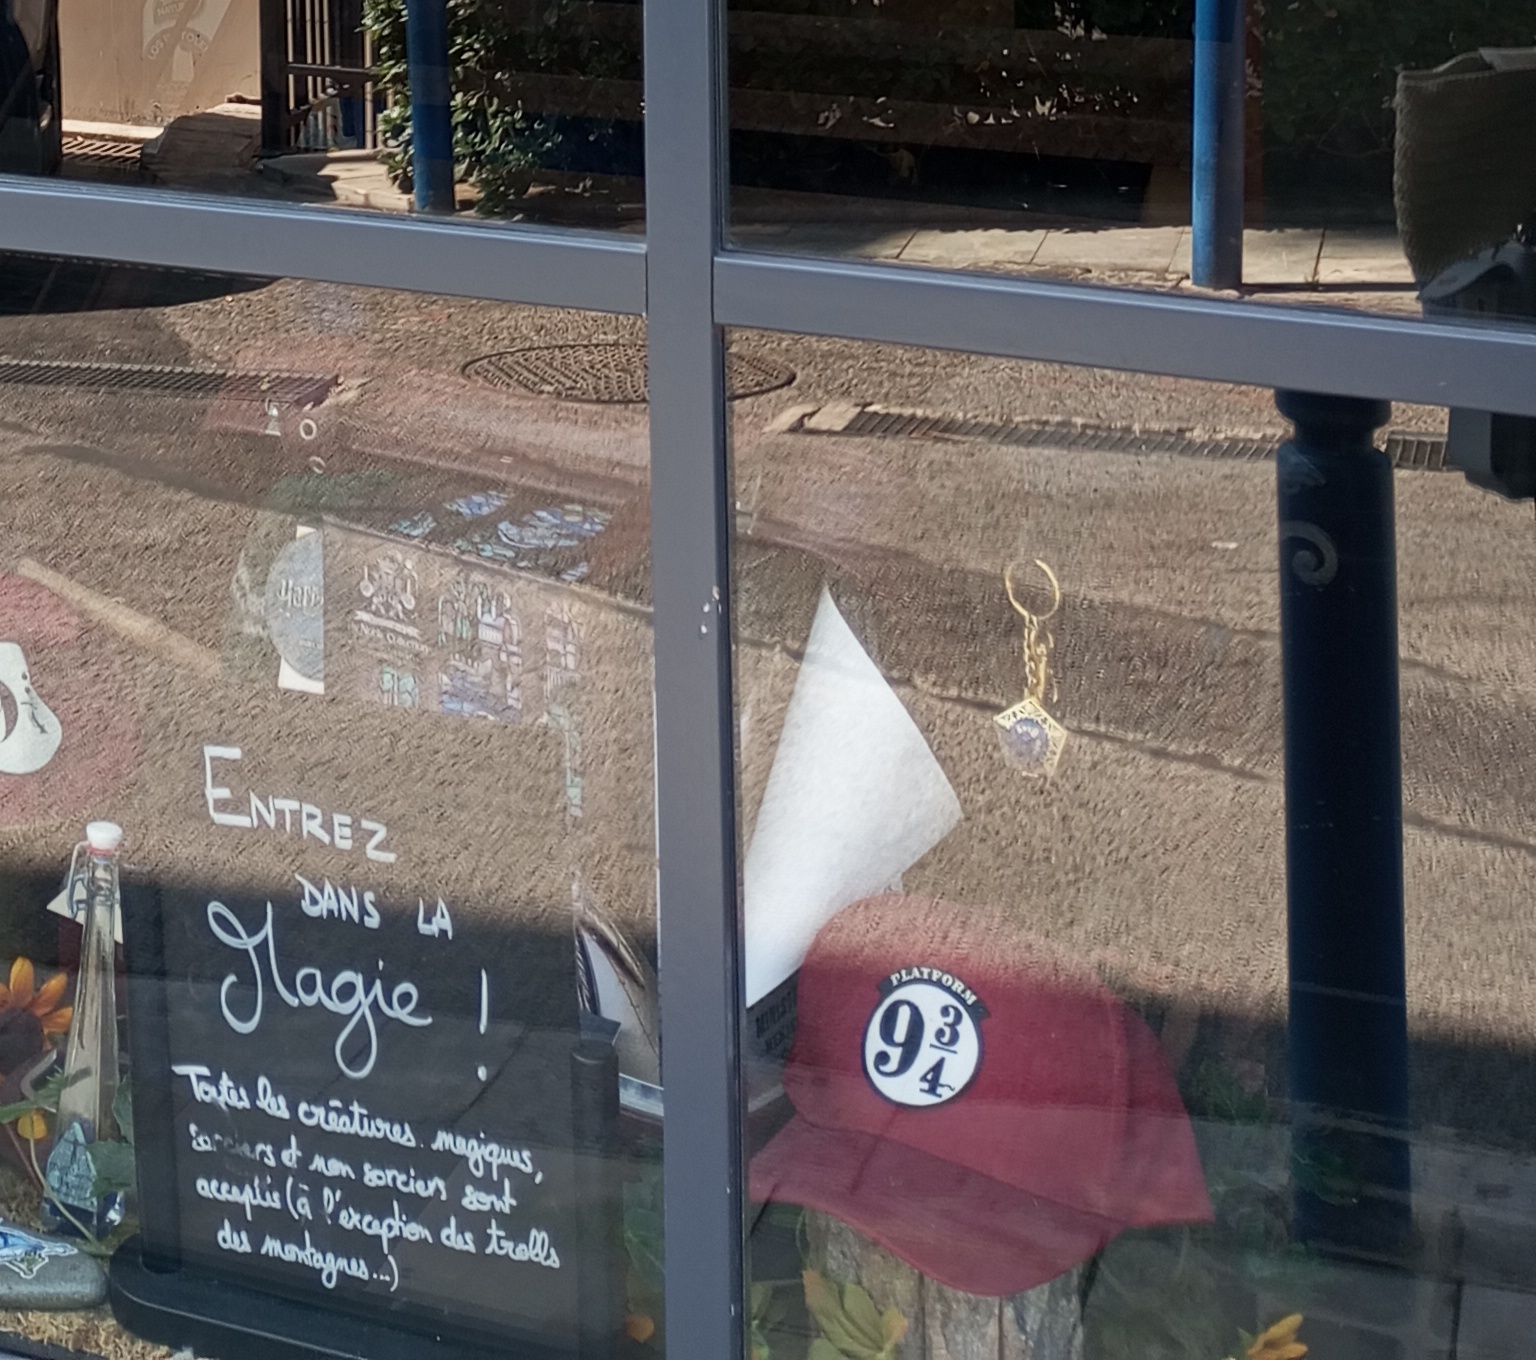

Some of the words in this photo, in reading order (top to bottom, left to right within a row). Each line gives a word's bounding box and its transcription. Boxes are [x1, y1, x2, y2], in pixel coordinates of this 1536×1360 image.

[295, 873, 381, 930] DANS
[417, 897, 453, 940] LA
[208, 900, 432, 1079] Magie
[890, 965, 978, 1007] PLATFORM
[172, 1065, 251, 1110] Toutes
[257, 1076, 290, 1120] les
[281, 1135, 301, 1169] et
[309, 1153, 356, 1180] non
[363, 1161, 446, 1201] sorciers
[462, 1178, 517, 1214] sont
[217, 1219, 252, 1254] des
[322, 1186, 433, 1254] l'exception
[441, 1215, 476, 1254] des
[485, 1220, 560, 1269] trolls
